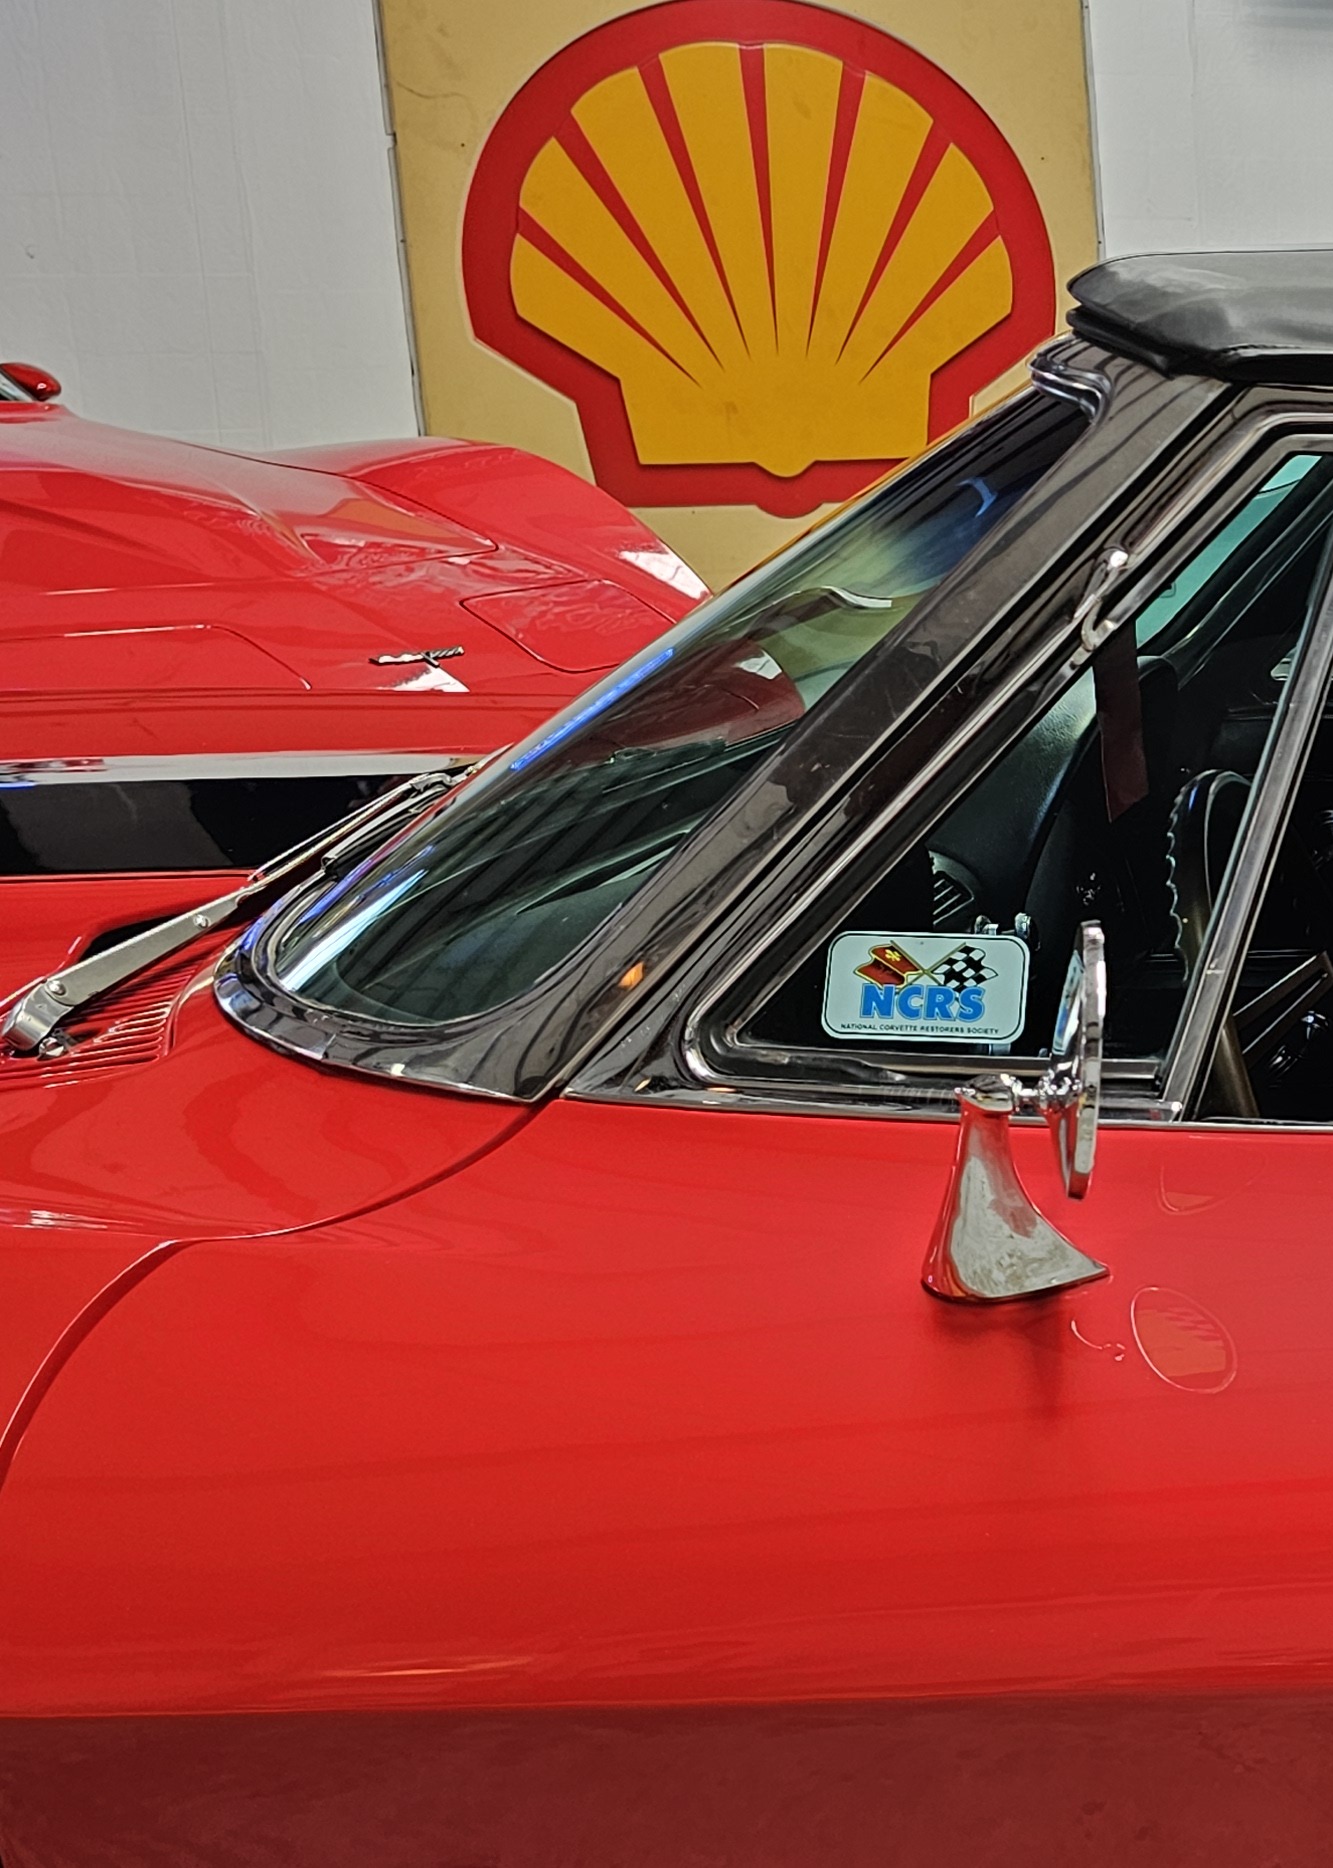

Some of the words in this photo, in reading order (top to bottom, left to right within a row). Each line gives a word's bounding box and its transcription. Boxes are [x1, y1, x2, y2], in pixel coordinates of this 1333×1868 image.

[860, 983, 985, 1022] NCRS
[840, 1022, 878, 1031] NATIONAL
[878, 1023, 918, 1032] CORVETTE
[919, 1025, 965, 1034] RESTORERS
[966, 1026, 1000, 1035] SOCIETY
